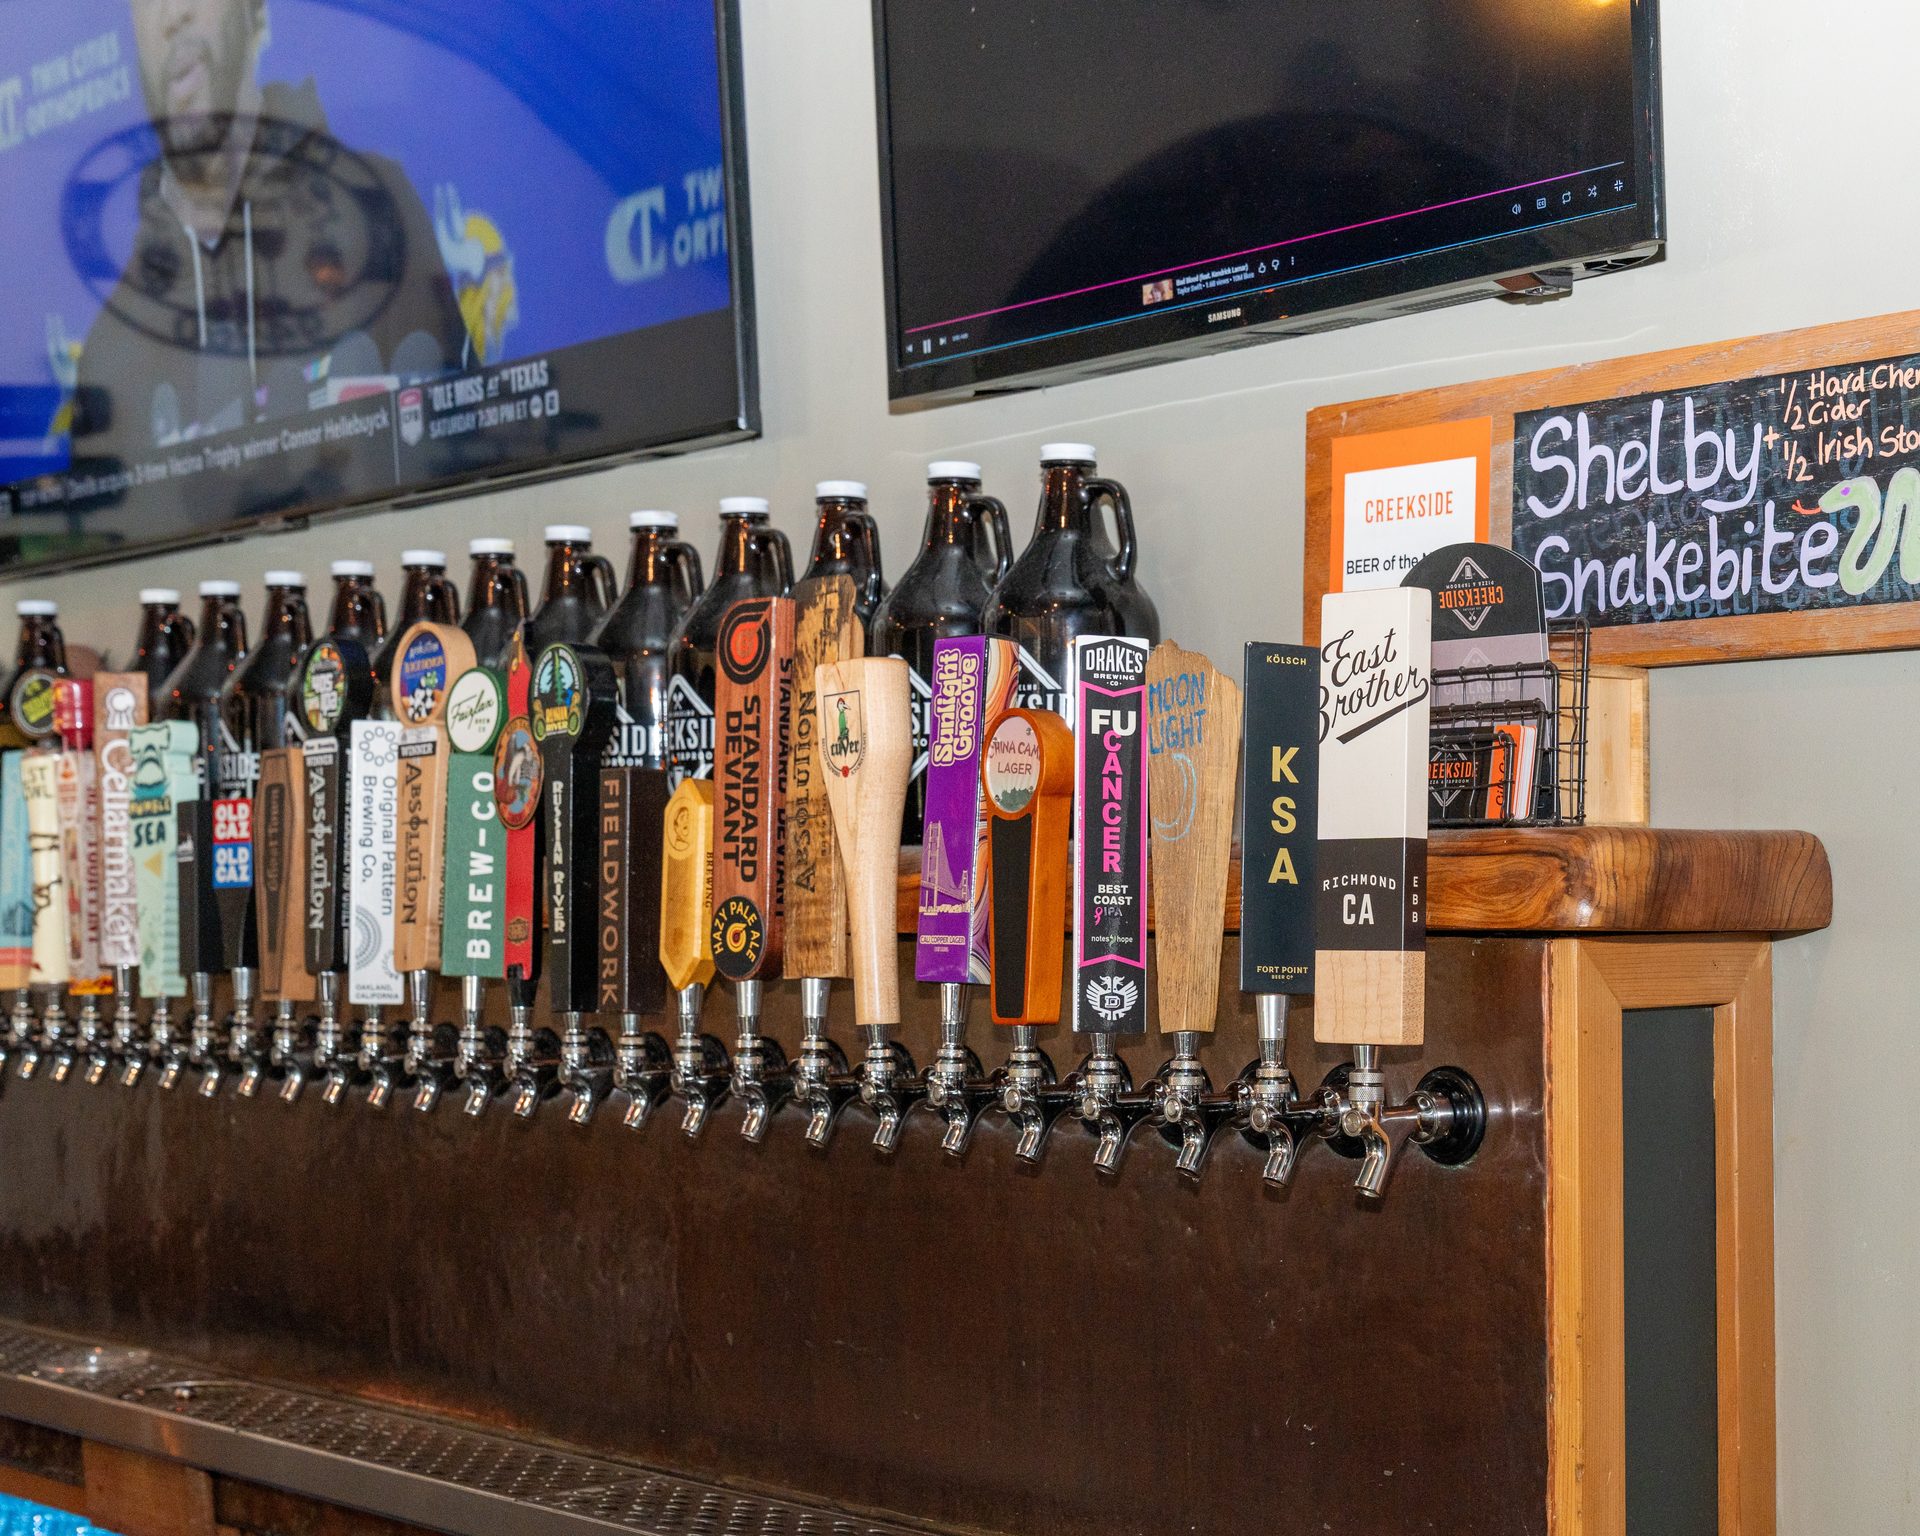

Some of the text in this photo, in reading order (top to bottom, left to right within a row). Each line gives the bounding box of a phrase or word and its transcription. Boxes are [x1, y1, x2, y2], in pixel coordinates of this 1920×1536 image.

[1207, 307, 1242, 323] SAMSUNG
[509, 358, 550, 394] TEXAS
[1806, 365, 1866, 401] Hard
[1808, 396, 1871, 425] Cider
[1527, 396, 1763, 519] Shelby
[1818, 425, 1874, 466] Irish
[1365, 490, 1454, 524] CREEKSIDE
[1346, 557, 1380, 575] BEER
[1383, 554, 1397, 571] of
[1399, 552, 1418, 570] the
[1533, 500, 1840, 619] Snakebite
[1438, 585, 1505, 609] CREEKSIDE
[1085, 643, 1143, 674] DRAKE'S
[1265, 654, 1308, 666] KÖLSCH
[1321, 627, 1398, 688] East
[1093, 673, 1135, 681] BREWING
[1148, 671, 1206, 719] MOON
[932, 648, 961, 767] Sunlight
[952, 654, 979, 760] Groove
[1319, 665, 1430, 742] Brother
[1090, 708, 1137, 737] FU
[1148, 708, 1207, 755] LIGHT
[997, 762, 1032, 775] LAGER
[723, 710, 744, 867] DEVIANT
[741, 694, 761, 883] STANDARD
[1101, 729, 1124, 874] CANCER
[214, 821, 250, 840] CAZ
[215, 803, 250, 822] OLD
[358, 775, 377, 884] Brewing Co.
[552, 780, 565, 866] RUSSIAN
[1267, 746, 1300, 885] KSA
[101, 738, 138, 958] Cellarmaker
[133, 820, 166, 849] SEA
[378, 775, 398, 917] Original Pattern
[214, 865, 250, 884] CAZ
[215, 847, 250, 866] OLD
[602, 779, 620, 1006] FIELDWORK
[1097, 884, 1129, 895] BEST
[1322, 873, 1397, 892] RICHMOND
[553, 870, 566, 934] RIVER
[1093, 895, 1133, 907] COAST
[1103, 906, 1123, 918] IPA
[1342, 893, 1375, 925] CA
[712, 900, 761, 963] HAZY PALE ALE
[1256, 965, 1309, 974] FORT POINT
